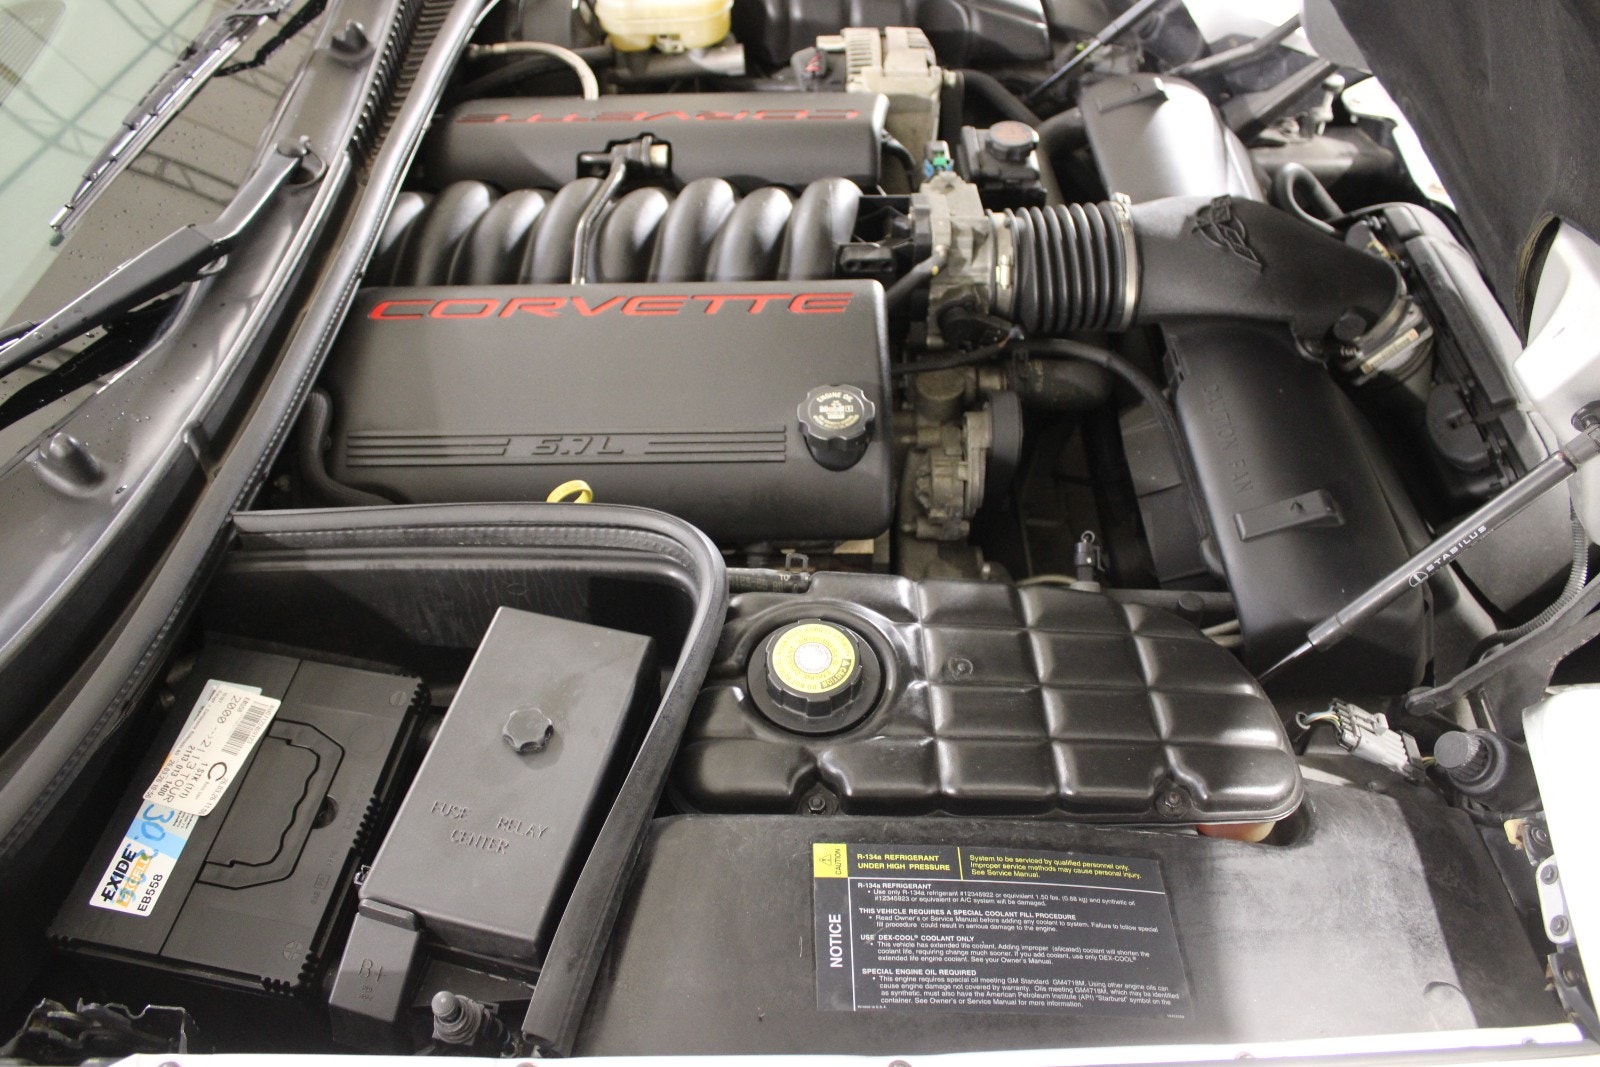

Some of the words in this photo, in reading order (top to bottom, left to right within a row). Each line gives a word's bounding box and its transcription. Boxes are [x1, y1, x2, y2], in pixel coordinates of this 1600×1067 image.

[367, 292, 855, 321] CORVETTE
[531, 437, 625, 456] 5.7L
[1426, 525, 1487, 572] STABILUS
[431, 801, 469, 819] FUSE
[496, 817, 549, 840] RELAY
[450, 829, 510, 855] CENTER
[101, 848, 137, 901] EXIDE
[970, 855, 995, 863] System
[1054, 860, 1080, 868] qualified
[1082, 861, 1113, 871] personnel
[1115, 864, 1130, 872] only.
[971, 862, 1000, 870] Improper
[1094, 869, 1121, 879] personal
[1123, 872, 1142, 880] injury.
[1014, 870, 1040, 878] Manual.
[137, 874, 163, 911] EB558
[829, 914, 843, 967] NOTICE
[1047, 1000, 1084, 1008] information.
